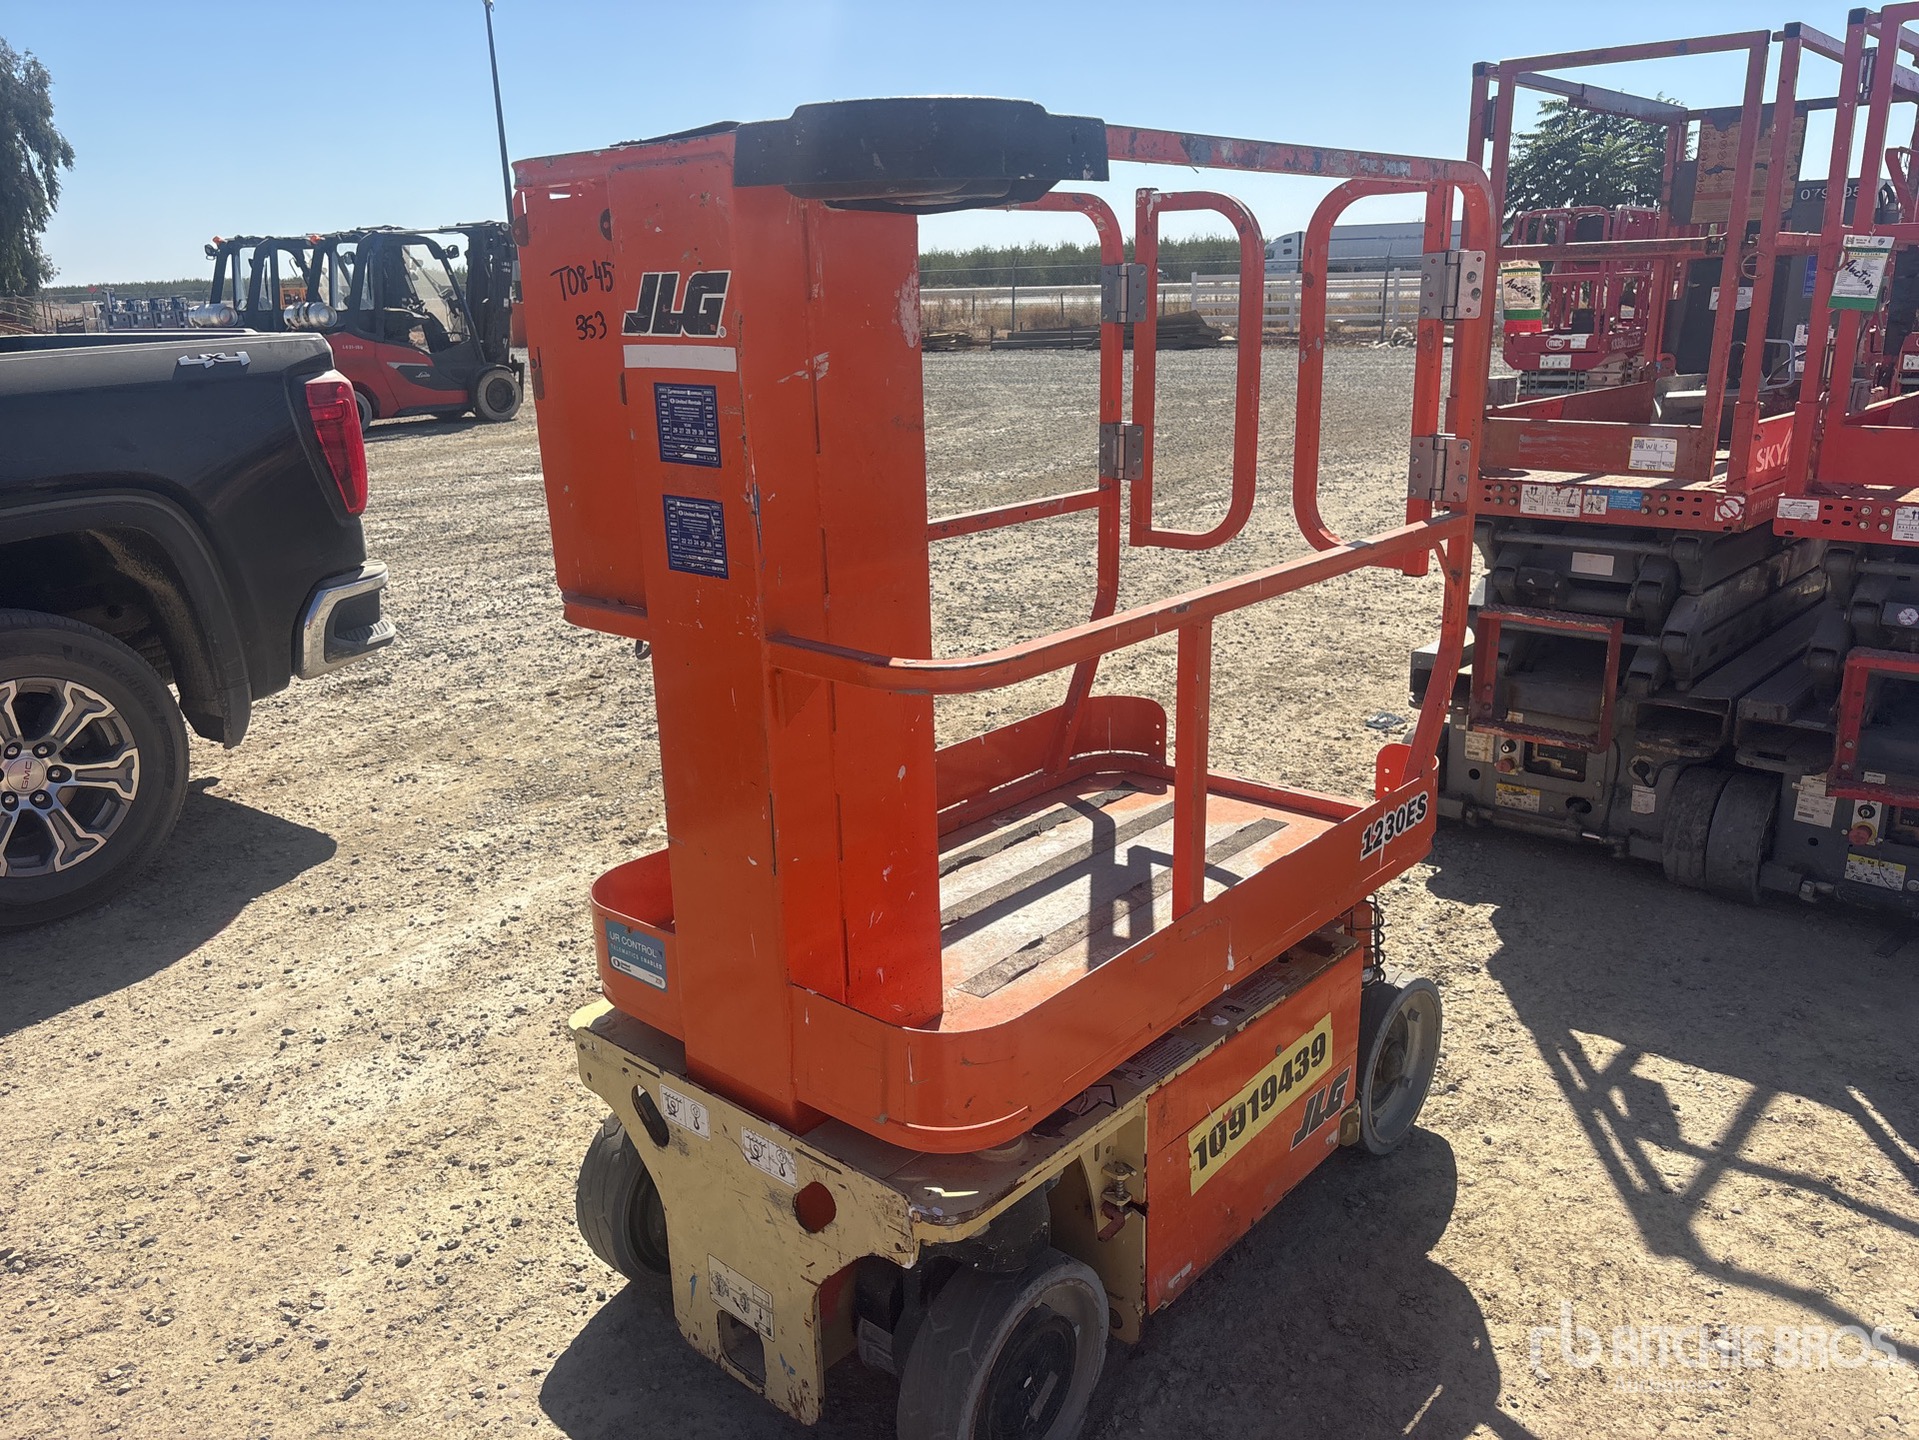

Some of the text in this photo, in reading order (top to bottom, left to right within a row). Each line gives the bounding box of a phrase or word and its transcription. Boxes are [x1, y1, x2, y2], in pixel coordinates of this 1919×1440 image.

[1505, 278, 1536, 303] Auction
[1844, 259, 1874, 294] Auction
[621, 270, 732, 338] JLG
[575, 311, 607, 340] 353
[21, 761, 32, 789] GMC
[1360, 791, 1428, 861] 1230ES
[610, 931, 657, 958] UR CONTROL
[640, 956, 662, 970] ENABLED
[1193, 1032, 1326, 1171] 10919439
[1290, 1065, 1352, 1152] JLG
